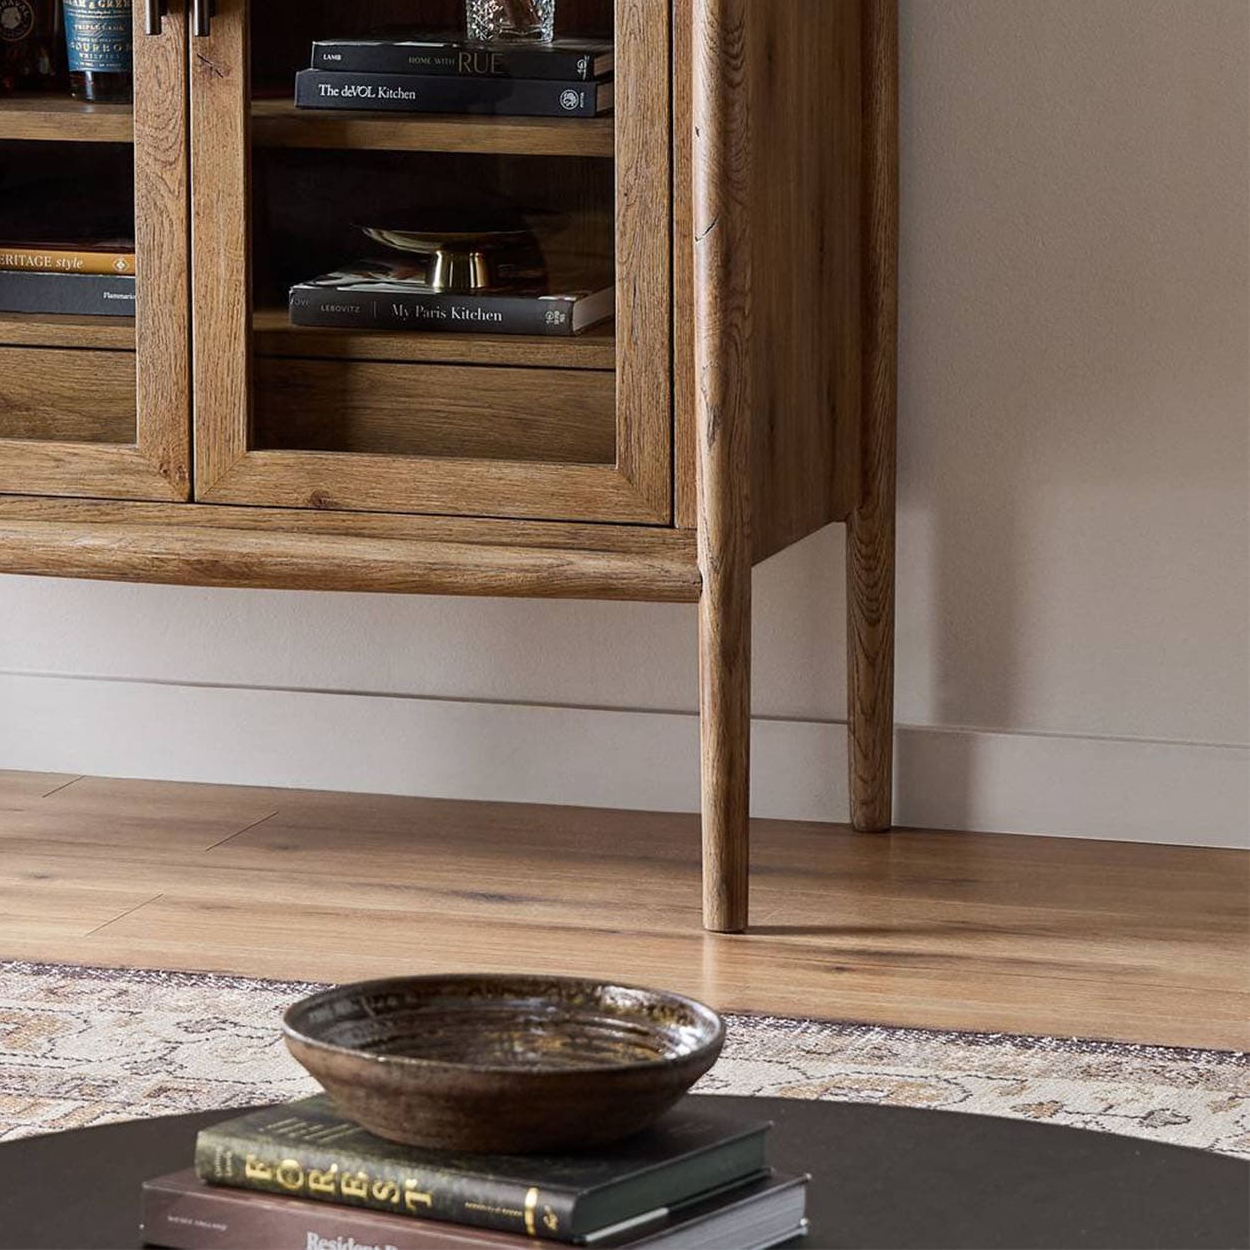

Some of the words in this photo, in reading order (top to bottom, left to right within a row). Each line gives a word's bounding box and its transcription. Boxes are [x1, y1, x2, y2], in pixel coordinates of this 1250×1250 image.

[408, 55, 432, 65] HOME
[457, 51, 505, 74] RUE
[318, 83, 340, 97] The
[340, 85, 376, 99] deVOL
[377, 86, 416, 101] Kitchen
[55, 257, 85, 271] style
[320, 304, 361, 314] LEBOVITZ
[391, 303, 410, 323] My
[415, 305, 448, 320] Paris
[451, 306, 503, 322] Kitchen
[245, 1155, 433, 1215] FOREST
